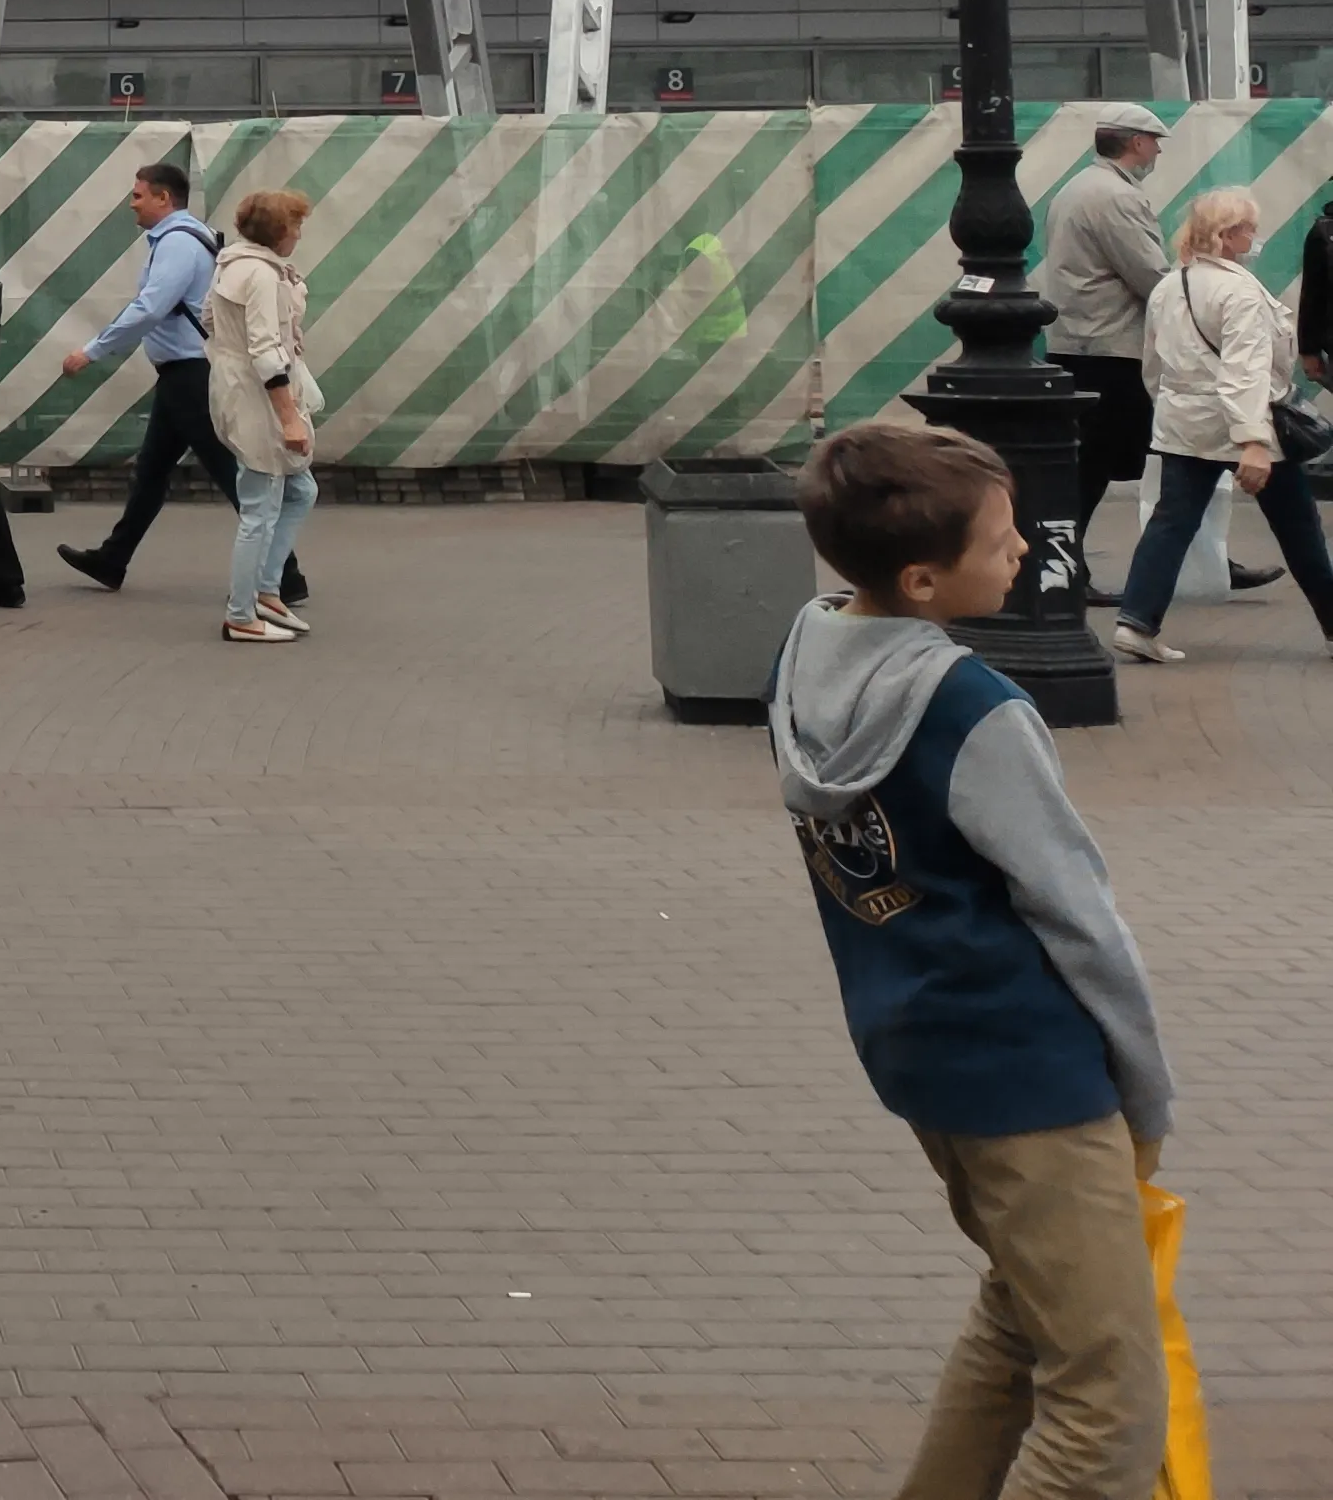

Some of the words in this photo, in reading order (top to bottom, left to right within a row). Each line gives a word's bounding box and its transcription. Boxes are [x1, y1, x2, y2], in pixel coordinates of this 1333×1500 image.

[120, 75, 135, 97] 6
[391, 73, 405, 94] 7
[668, 69, 683, 91] 8
